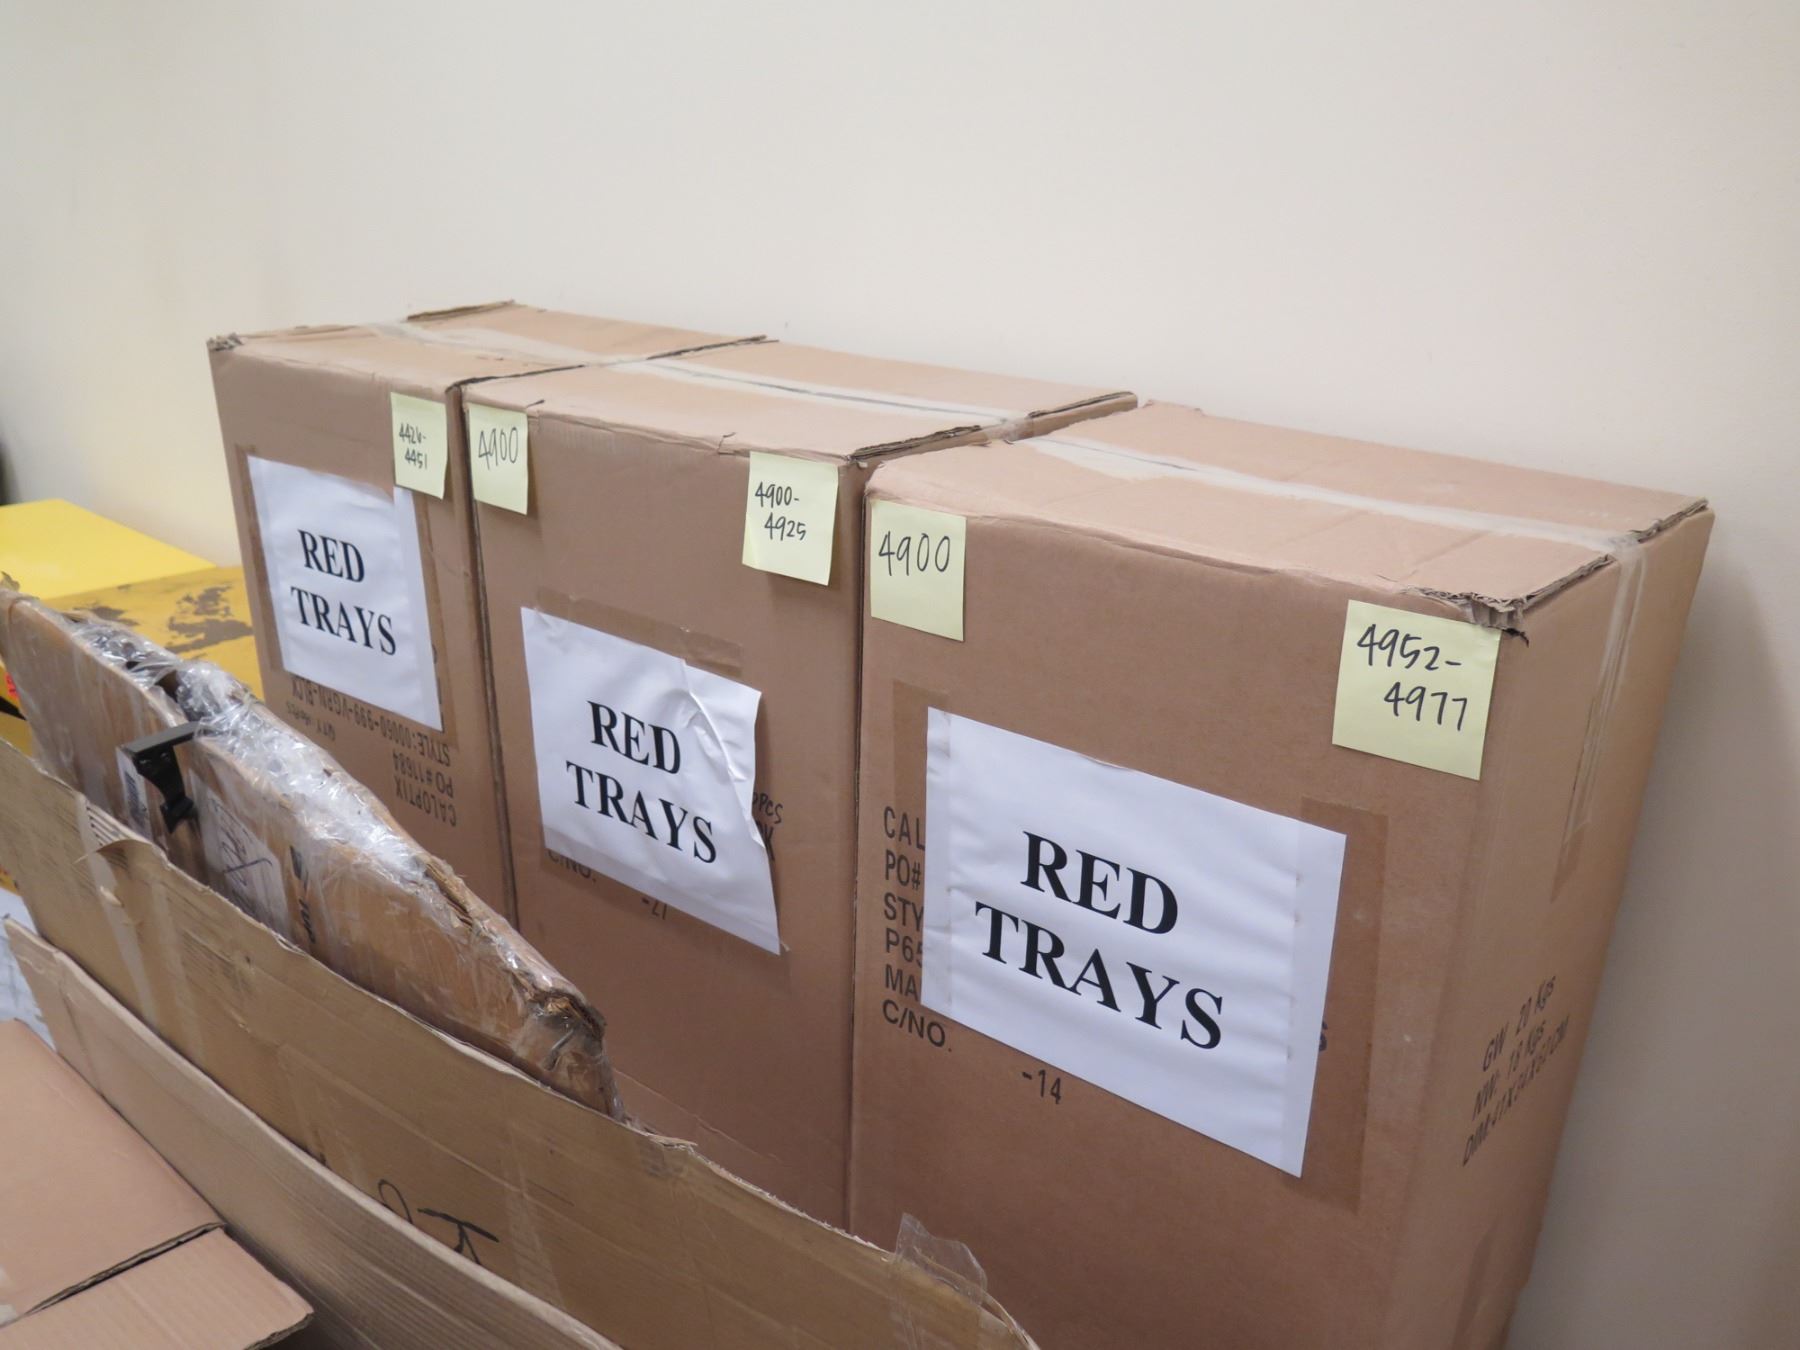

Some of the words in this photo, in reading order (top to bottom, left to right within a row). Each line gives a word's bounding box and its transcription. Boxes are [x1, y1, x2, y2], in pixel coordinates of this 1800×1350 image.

[404, 447, 428, 470] 4451
[477, 426, 519, 470] 4900
[754, 481, 800, 508] 4900-
[764, 511, 807, 541] 4925
[297, 529, 365, 584] RED
[878, 531, 951, 576] 4900
[290, 586, 397, 656] TRAYS
[1356, 623, 1462, 671] 4952-
[1383, 681, 1468, 731] 4977
[586, 700, 682, 775] RED
[565, 760, 718, 865] TRAYS
[1020, 830, 1179, 935] RED
[975, 901, 1223, 1051] TRAYS
[882, 999, 953, 1053] C/NO.
